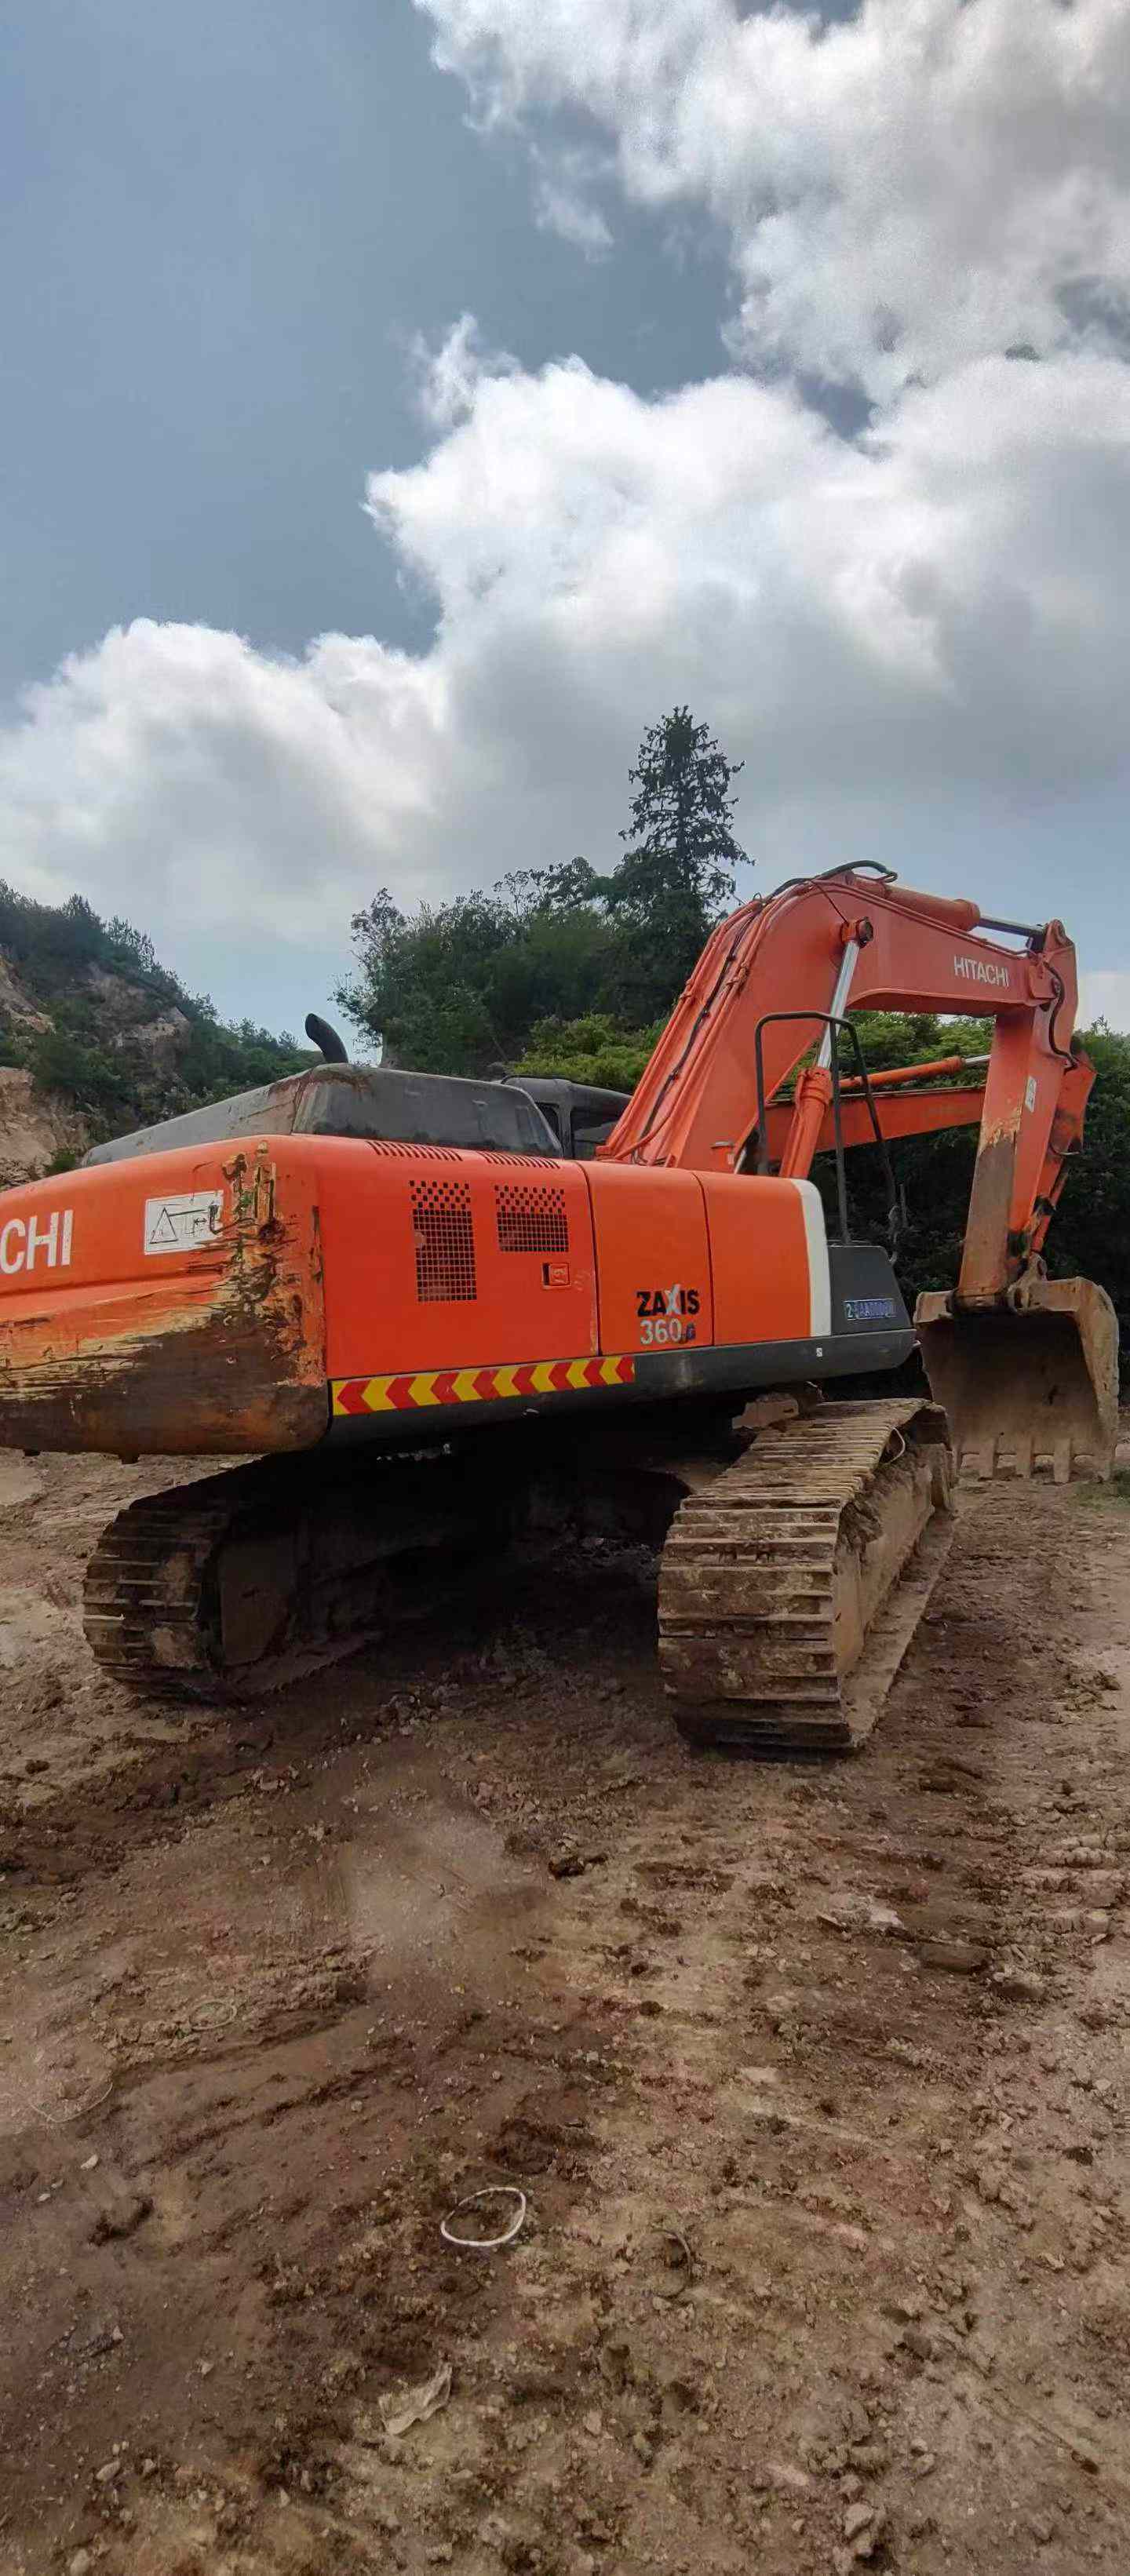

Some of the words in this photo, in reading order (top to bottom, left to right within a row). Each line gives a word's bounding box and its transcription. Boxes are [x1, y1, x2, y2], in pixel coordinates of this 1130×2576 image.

[953, 955, 1010, 987] HITACHI
[0, 1209, 74, 1274] CHI
[636, 1284, 700, 1317] ZAXIS
